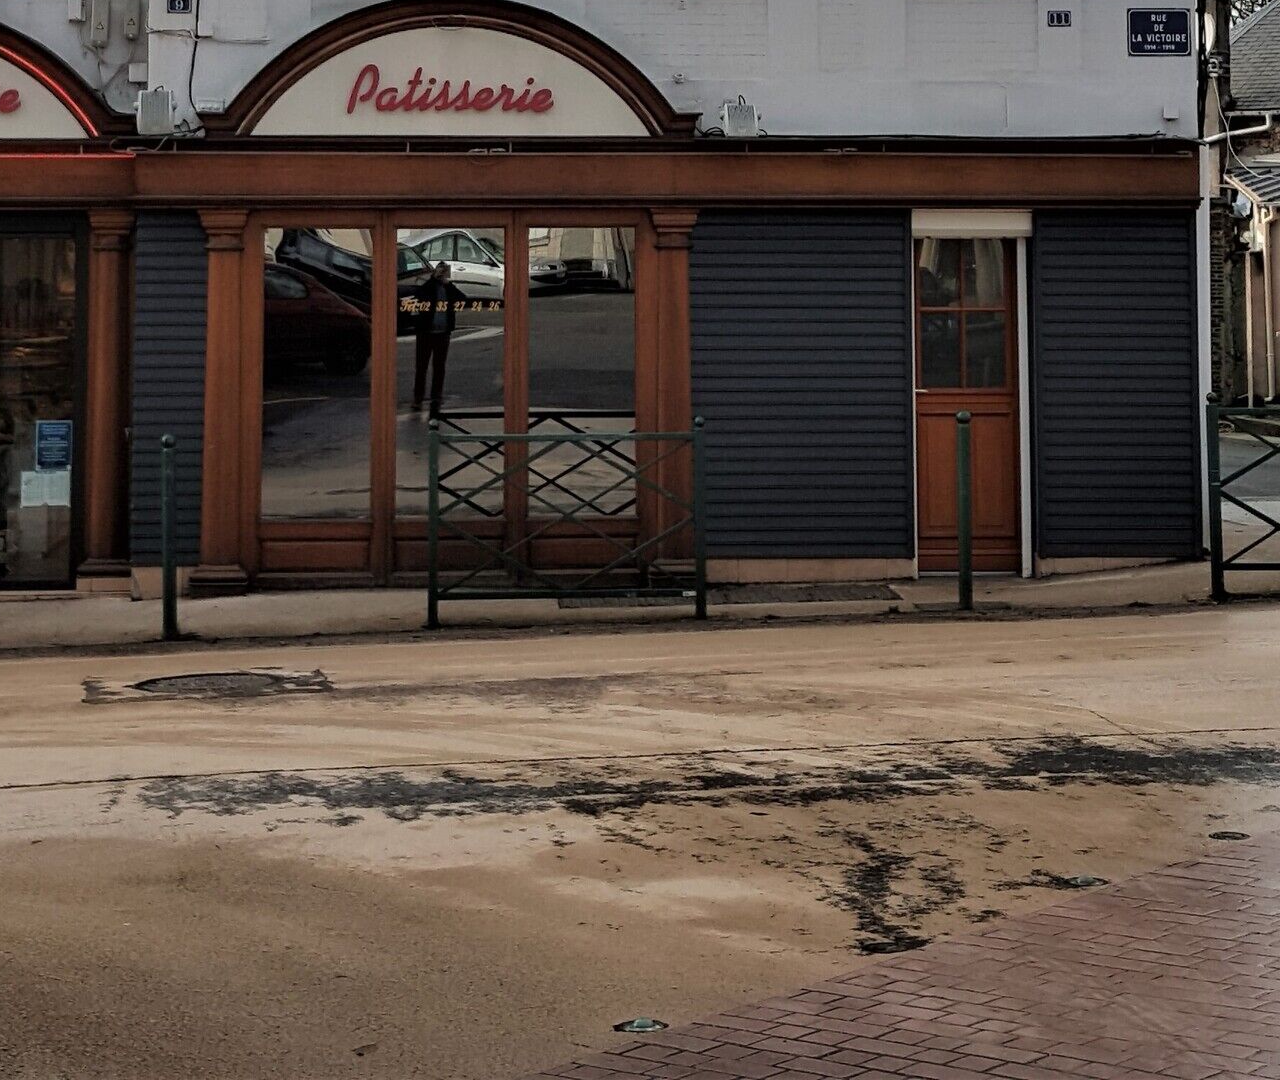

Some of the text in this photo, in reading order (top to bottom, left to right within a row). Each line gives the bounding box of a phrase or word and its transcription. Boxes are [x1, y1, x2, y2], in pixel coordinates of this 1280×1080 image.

[1150, 14, 1167, 22] RUE
[1153, 24, 1164, 32] DE
[1132, 34, 1187, 42] LA VICTOIRE
[346, 63, 555, 114] Patisserie
[436, 301, 449, 312] 35
[454, 301, 466, 312] 27
[471, 301, 483, 312] 24
[488, 301, 501, 312] 26
